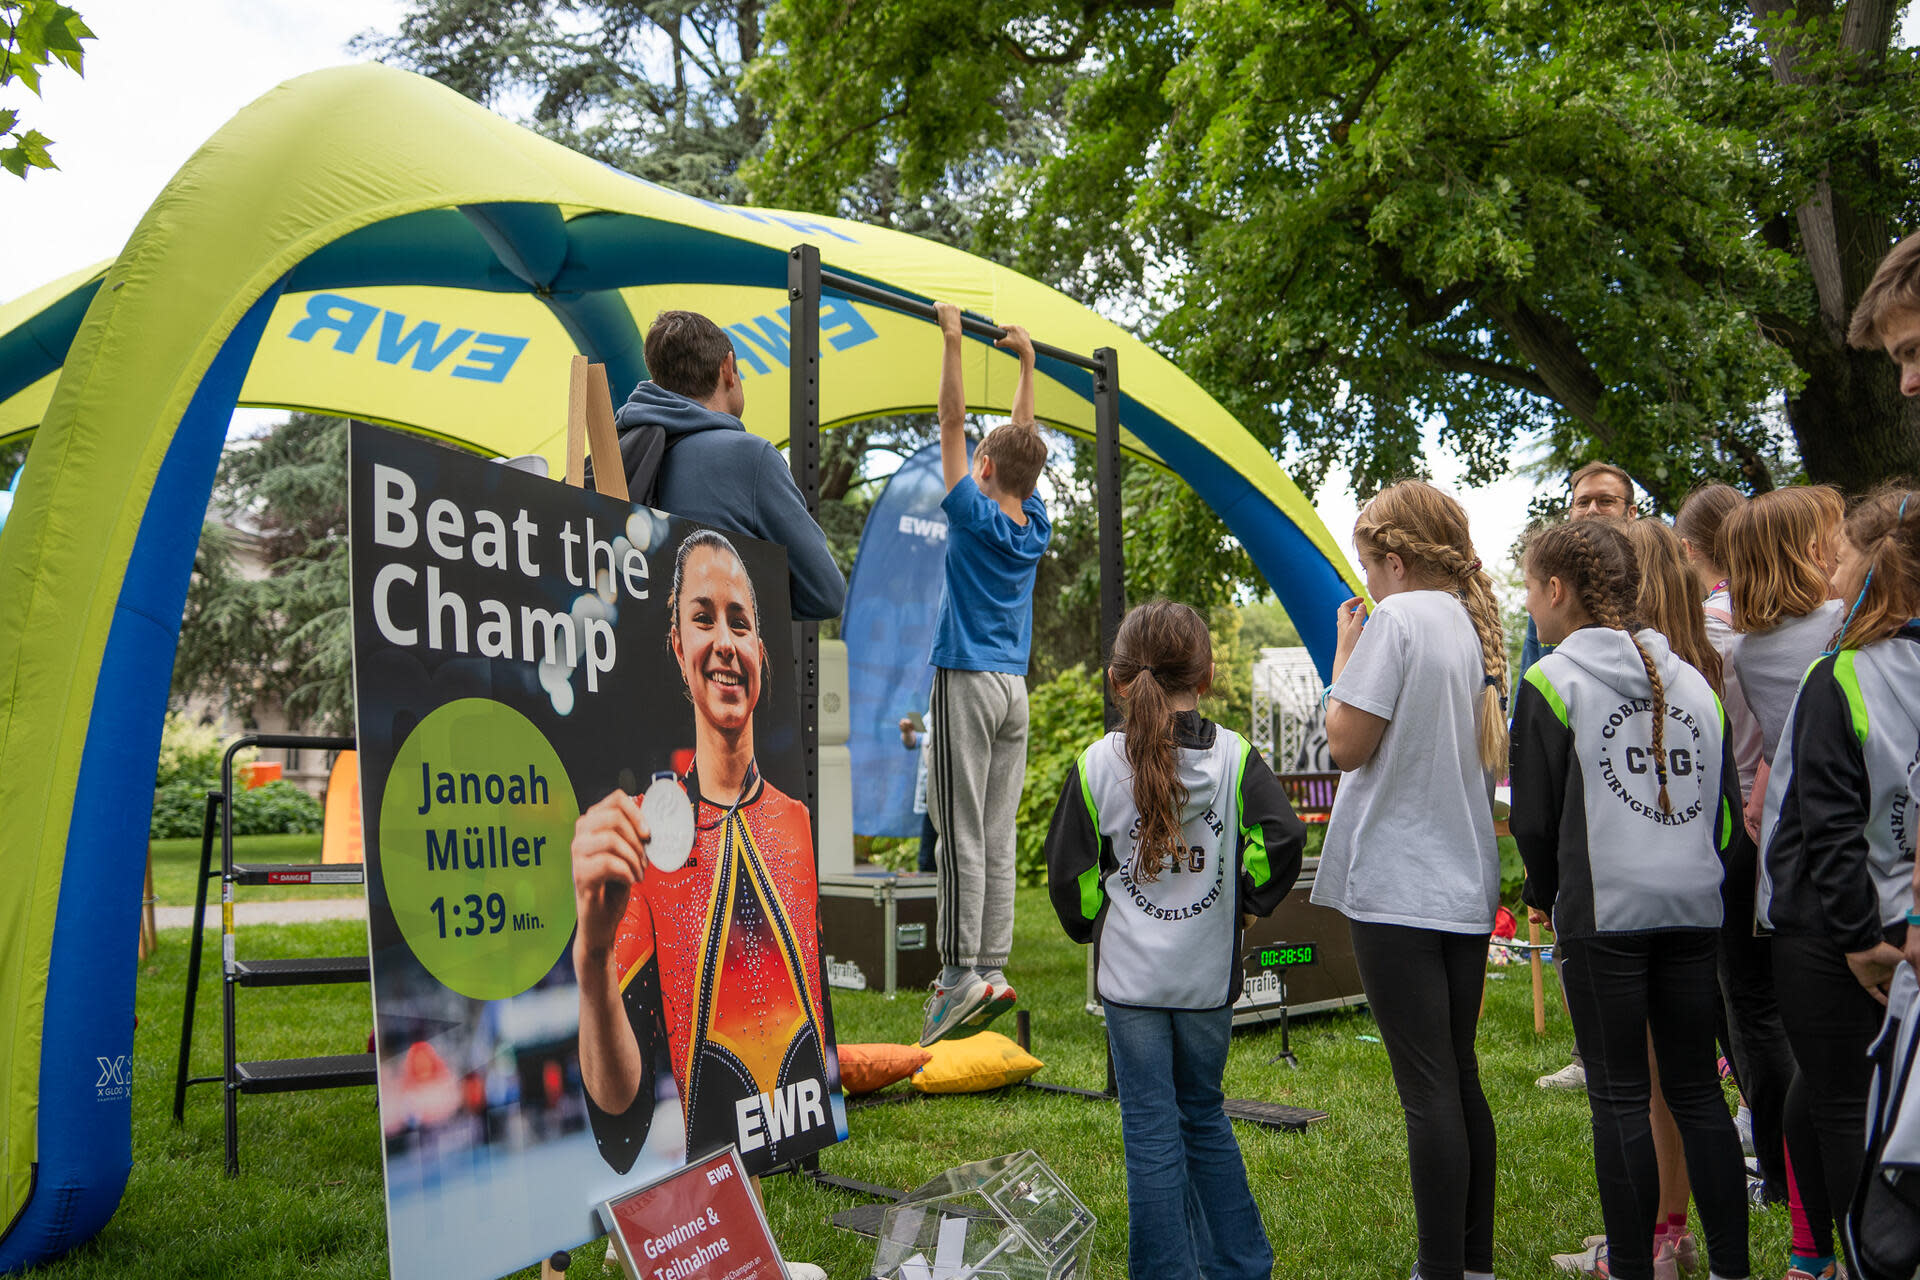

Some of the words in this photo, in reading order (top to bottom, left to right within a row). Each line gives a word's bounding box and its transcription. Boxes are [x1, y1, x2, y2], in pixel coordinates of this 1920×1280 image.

[373, 463, 540, 578] Beat
[559, 517, 650, 600] the
[899, 515, 946, 540] EWR
[373, 562, 617, 693] Champ
[1602, 699, 1700, 742] COBLEZER
[417, 761, 550, 816] Janoah
[425, 826, 547, 872] Müller
[429, 892, 506, 940] 1:39
[512, 912, 545, 932] Min.
[1261, 947, 1312, 967] 00:28:50
[736, 1078, 826, 1154] EWR
[706, 1163, 733, 1186] EWR
[643, 1216, 707, 1260] Gewinne
[706, 1207, 720, 1226] &
[654, 1237, 730, 1280] Teilnahme
